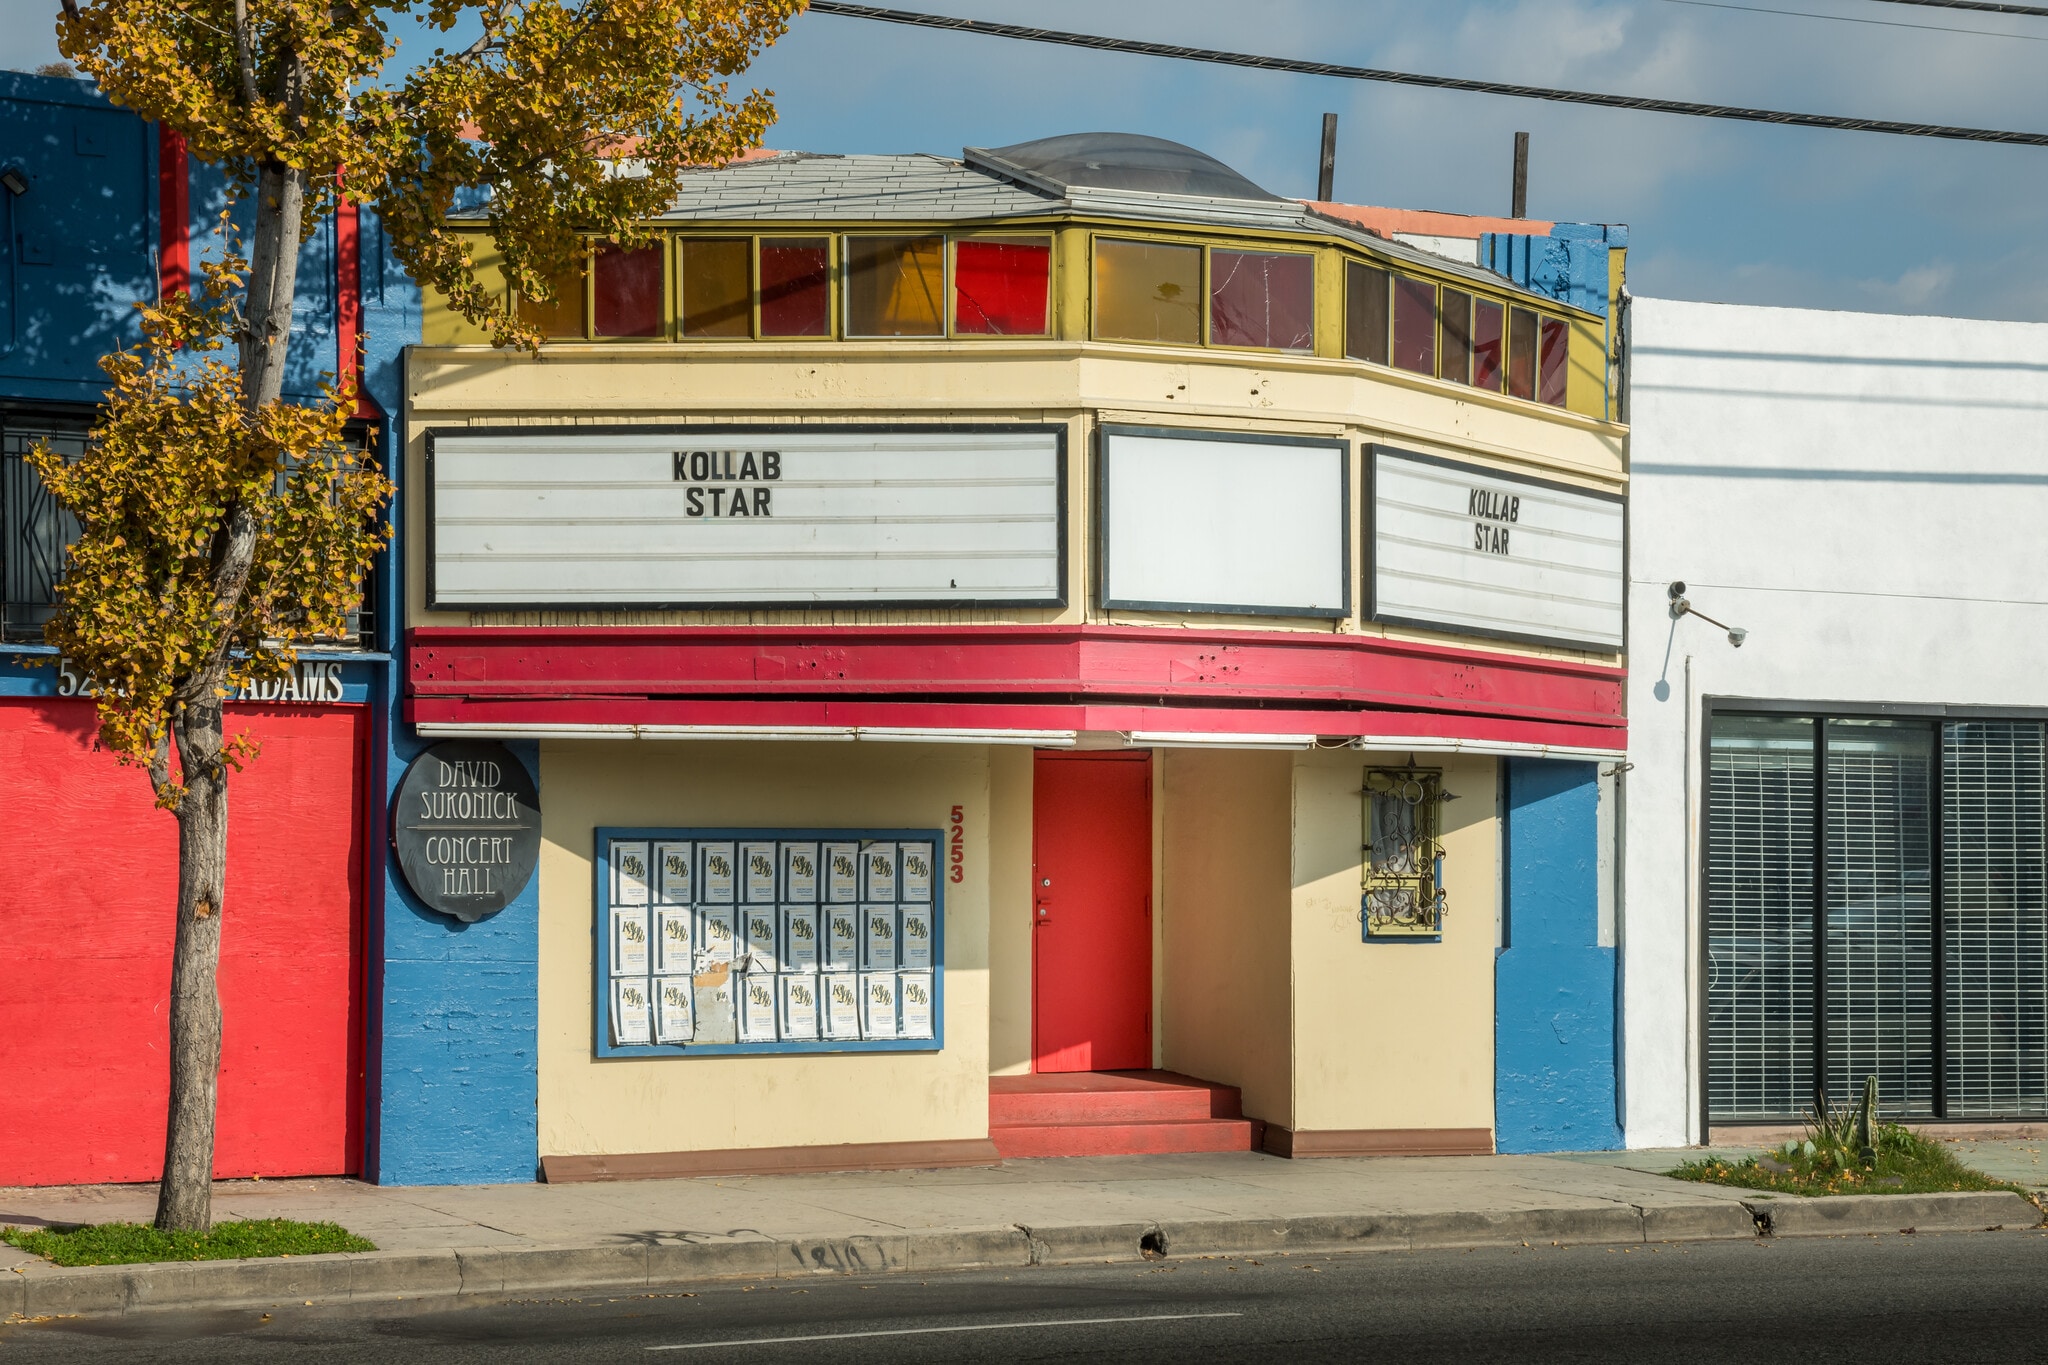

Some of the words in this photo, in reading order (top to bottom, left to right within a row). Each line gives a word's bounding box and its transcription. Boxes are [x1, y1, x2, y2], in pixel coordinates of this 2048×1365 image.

[673, 451, 781, 481] KOLLAB
[686, 487, 771, 517] STAR
[1468, 488, 1520, 523] KOLLAB
[1475, 522, 1510, 555] STAR
[438, 760, 501, 788] DAVID
[420, 791, 519, 819] SUKONICK
[425, 836, 514, 865] CONCERT
[950, 804, 964, 884] 5253
[442, 867, 496, 896] HALL
